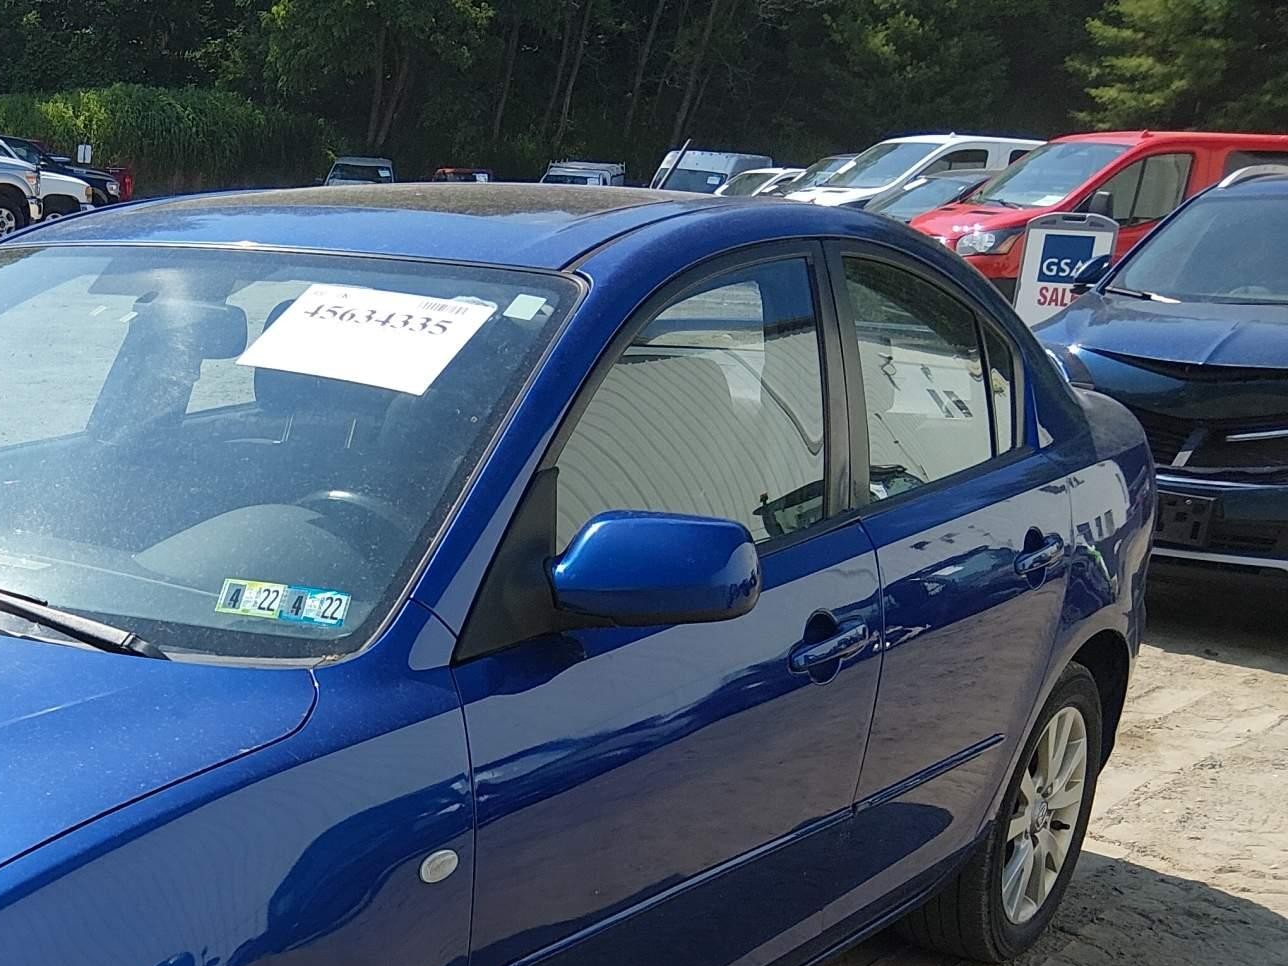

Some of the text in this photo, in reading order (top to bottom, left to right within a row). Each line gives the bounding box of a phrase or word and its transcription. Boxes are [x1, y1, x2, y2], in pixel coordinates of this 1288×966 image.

[303, 303, 453, 336] 45634335
[229, 588, 280, 612] 4 22
[291, 595, 343, 620] 4 22
